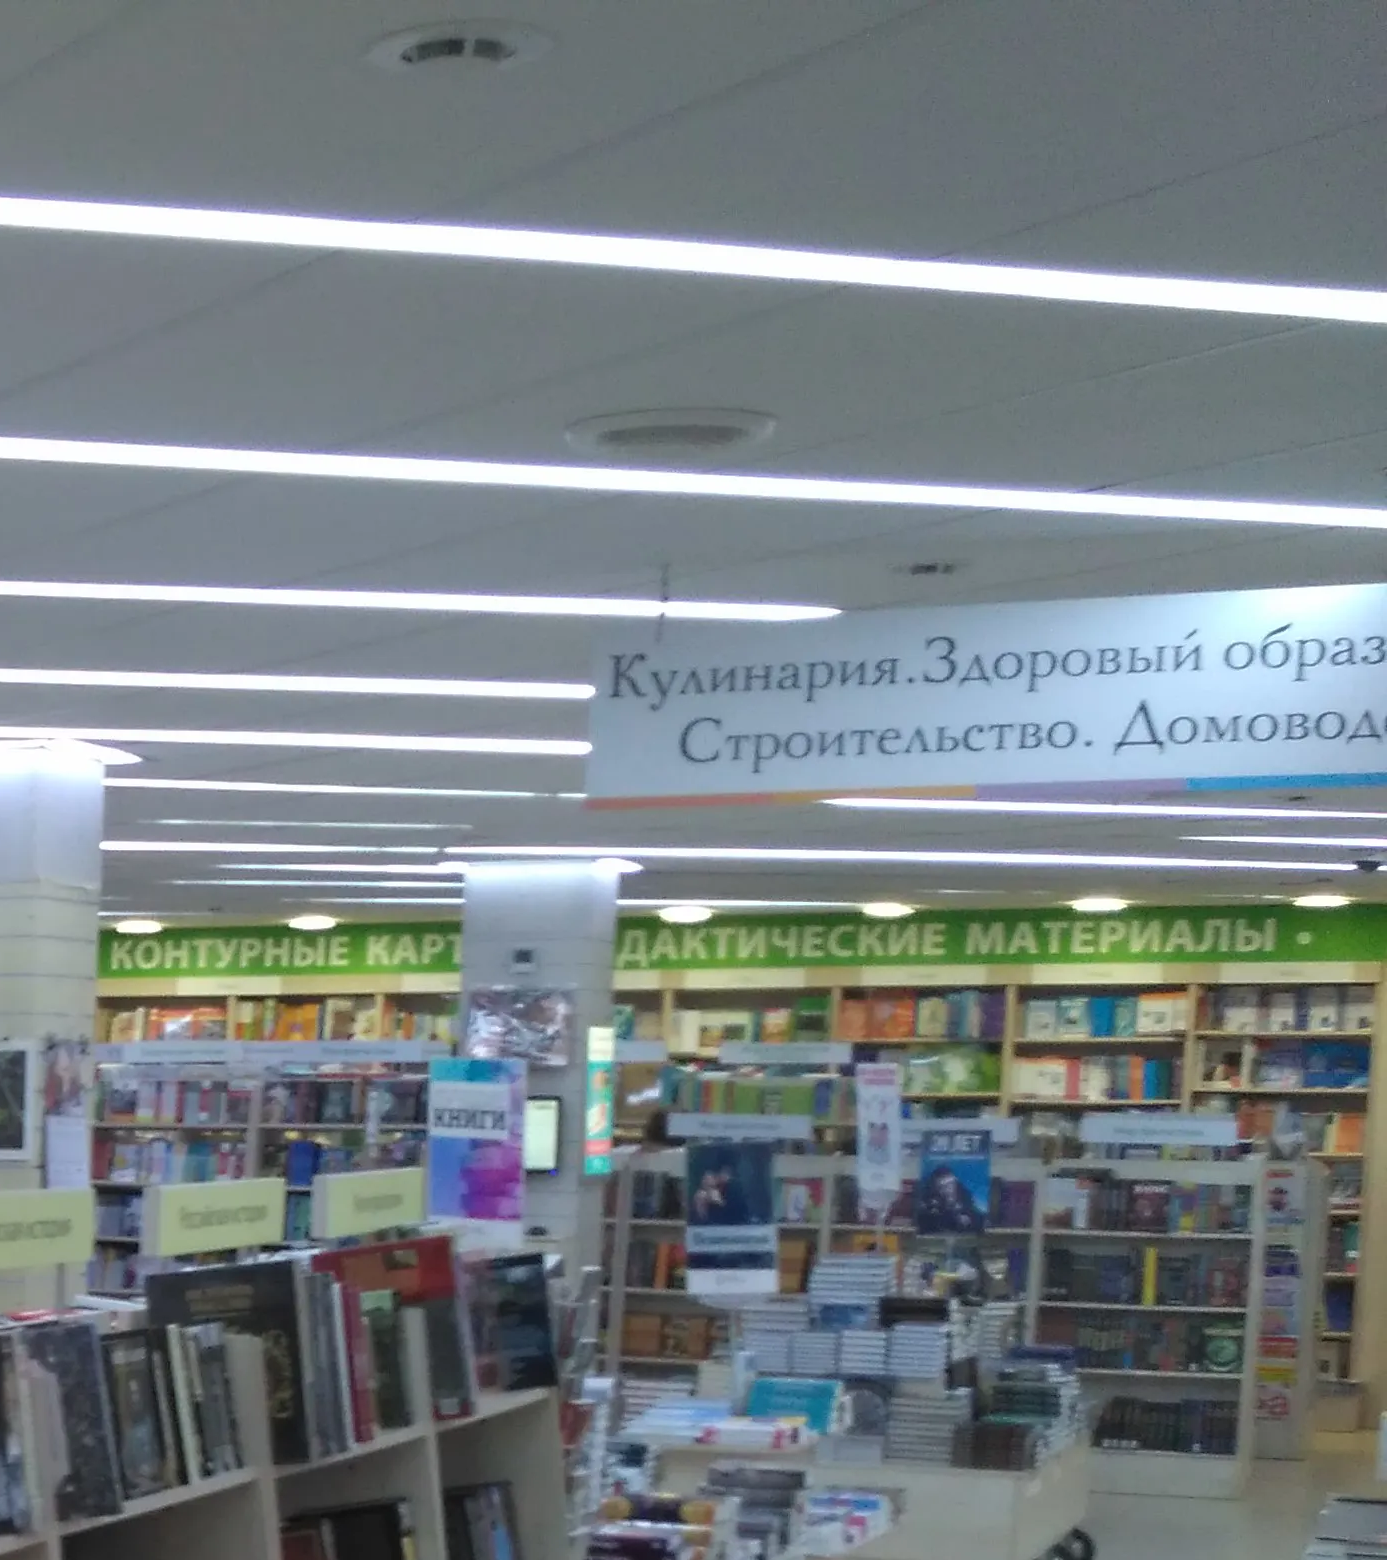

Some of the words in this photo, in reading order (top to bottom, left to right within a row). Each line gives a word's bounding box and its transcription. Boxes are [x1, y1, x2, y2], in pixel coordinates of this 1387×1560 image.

[1223, 623, 1387, 681] образ
[678, 716, 1094, 773] Строительство.
[1113, 701, 1387, 756] Домовод
[109, 934, 351, 971] КОНТУРНЫЕ
[966, 917, 1279, 959] МАТЕРИАЛЫ
[434, 1108, 507, 1131] КНИГИ
